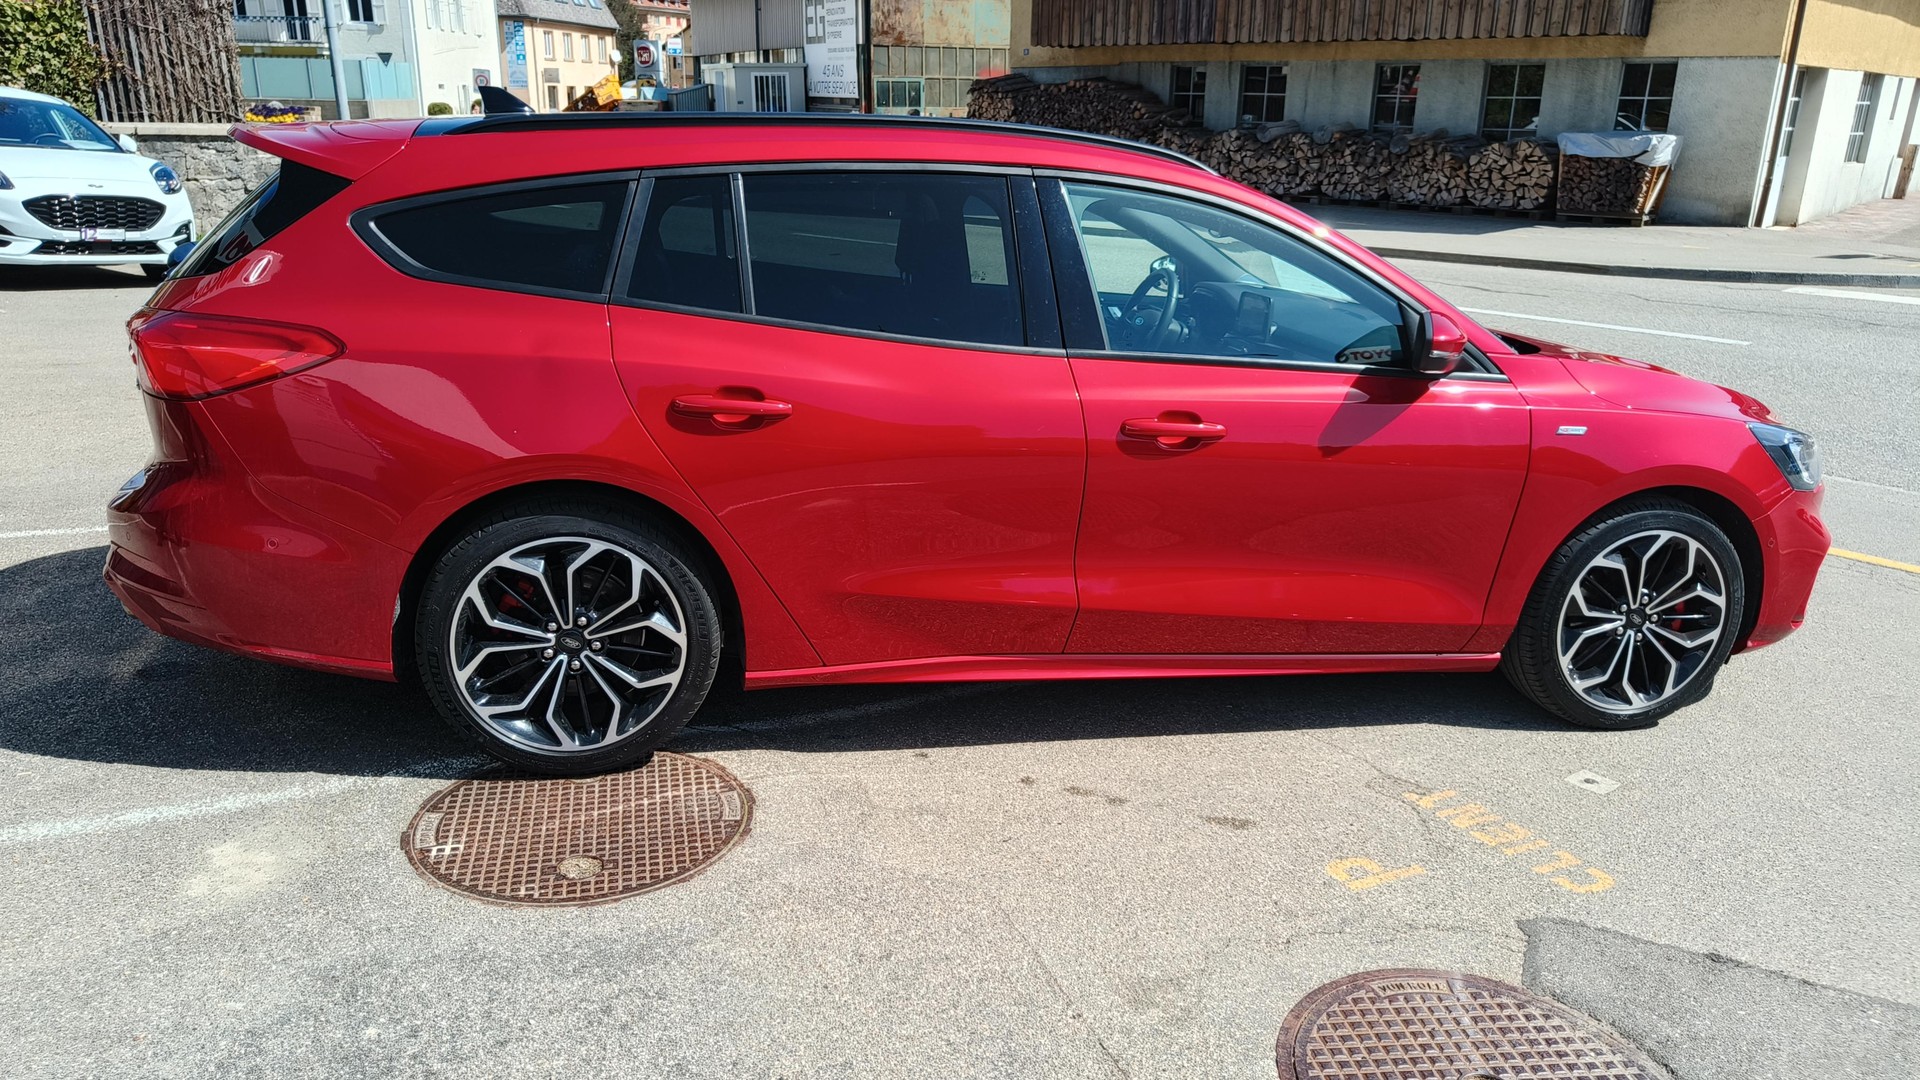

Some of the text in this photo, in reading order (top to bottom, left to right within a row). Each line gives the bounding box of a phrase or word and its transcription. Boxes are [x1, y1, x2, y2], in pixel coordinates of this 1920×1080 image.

[822, 64, 844, 78] 45 ANS
[831, 81, 856, 94] SERVICE
[1402, 790, 1616, 894] CLIENT
[1325, 857, 1425, 891] P
